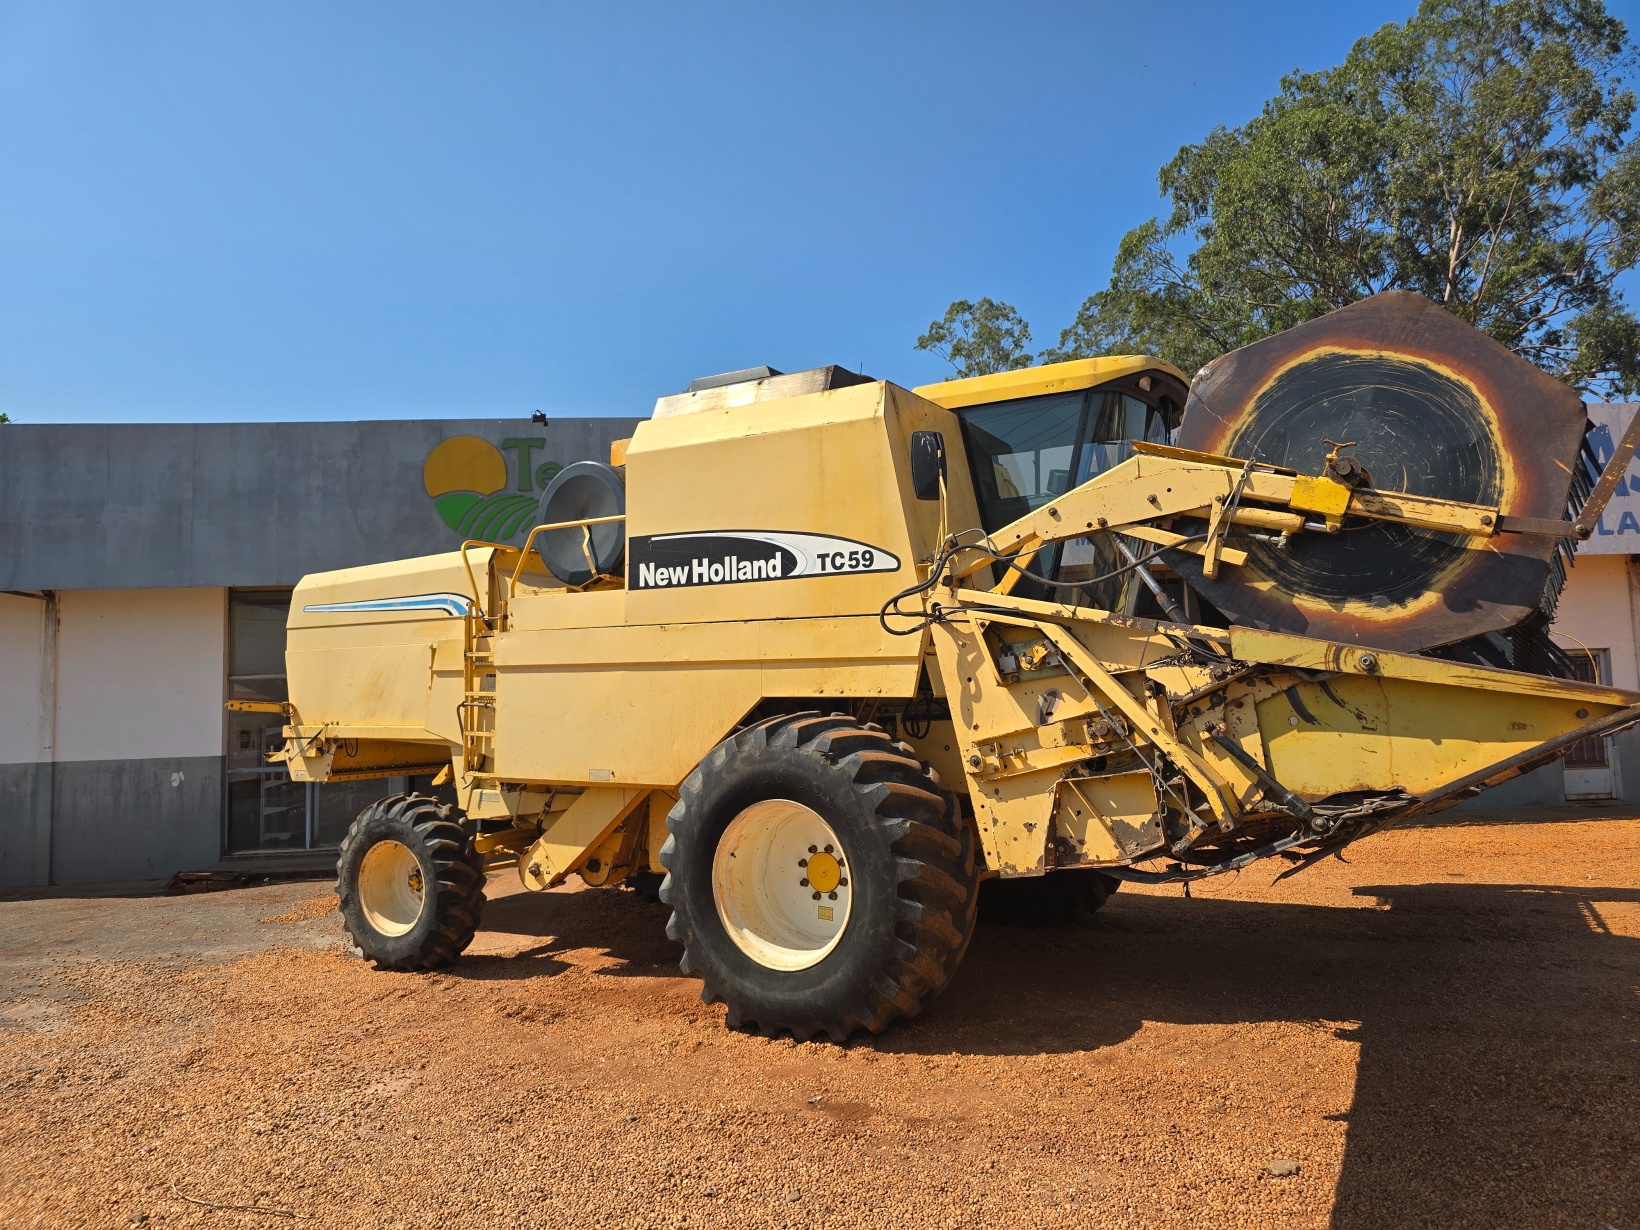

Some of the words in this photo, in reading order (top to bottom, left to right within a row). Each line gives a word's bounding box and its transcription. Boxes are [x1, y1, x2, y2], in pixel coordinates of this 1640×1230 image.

[639, 562, 690, 588] New
[692, 552, 782, 583] Holland
[816, 549, 875, 572] TC59
